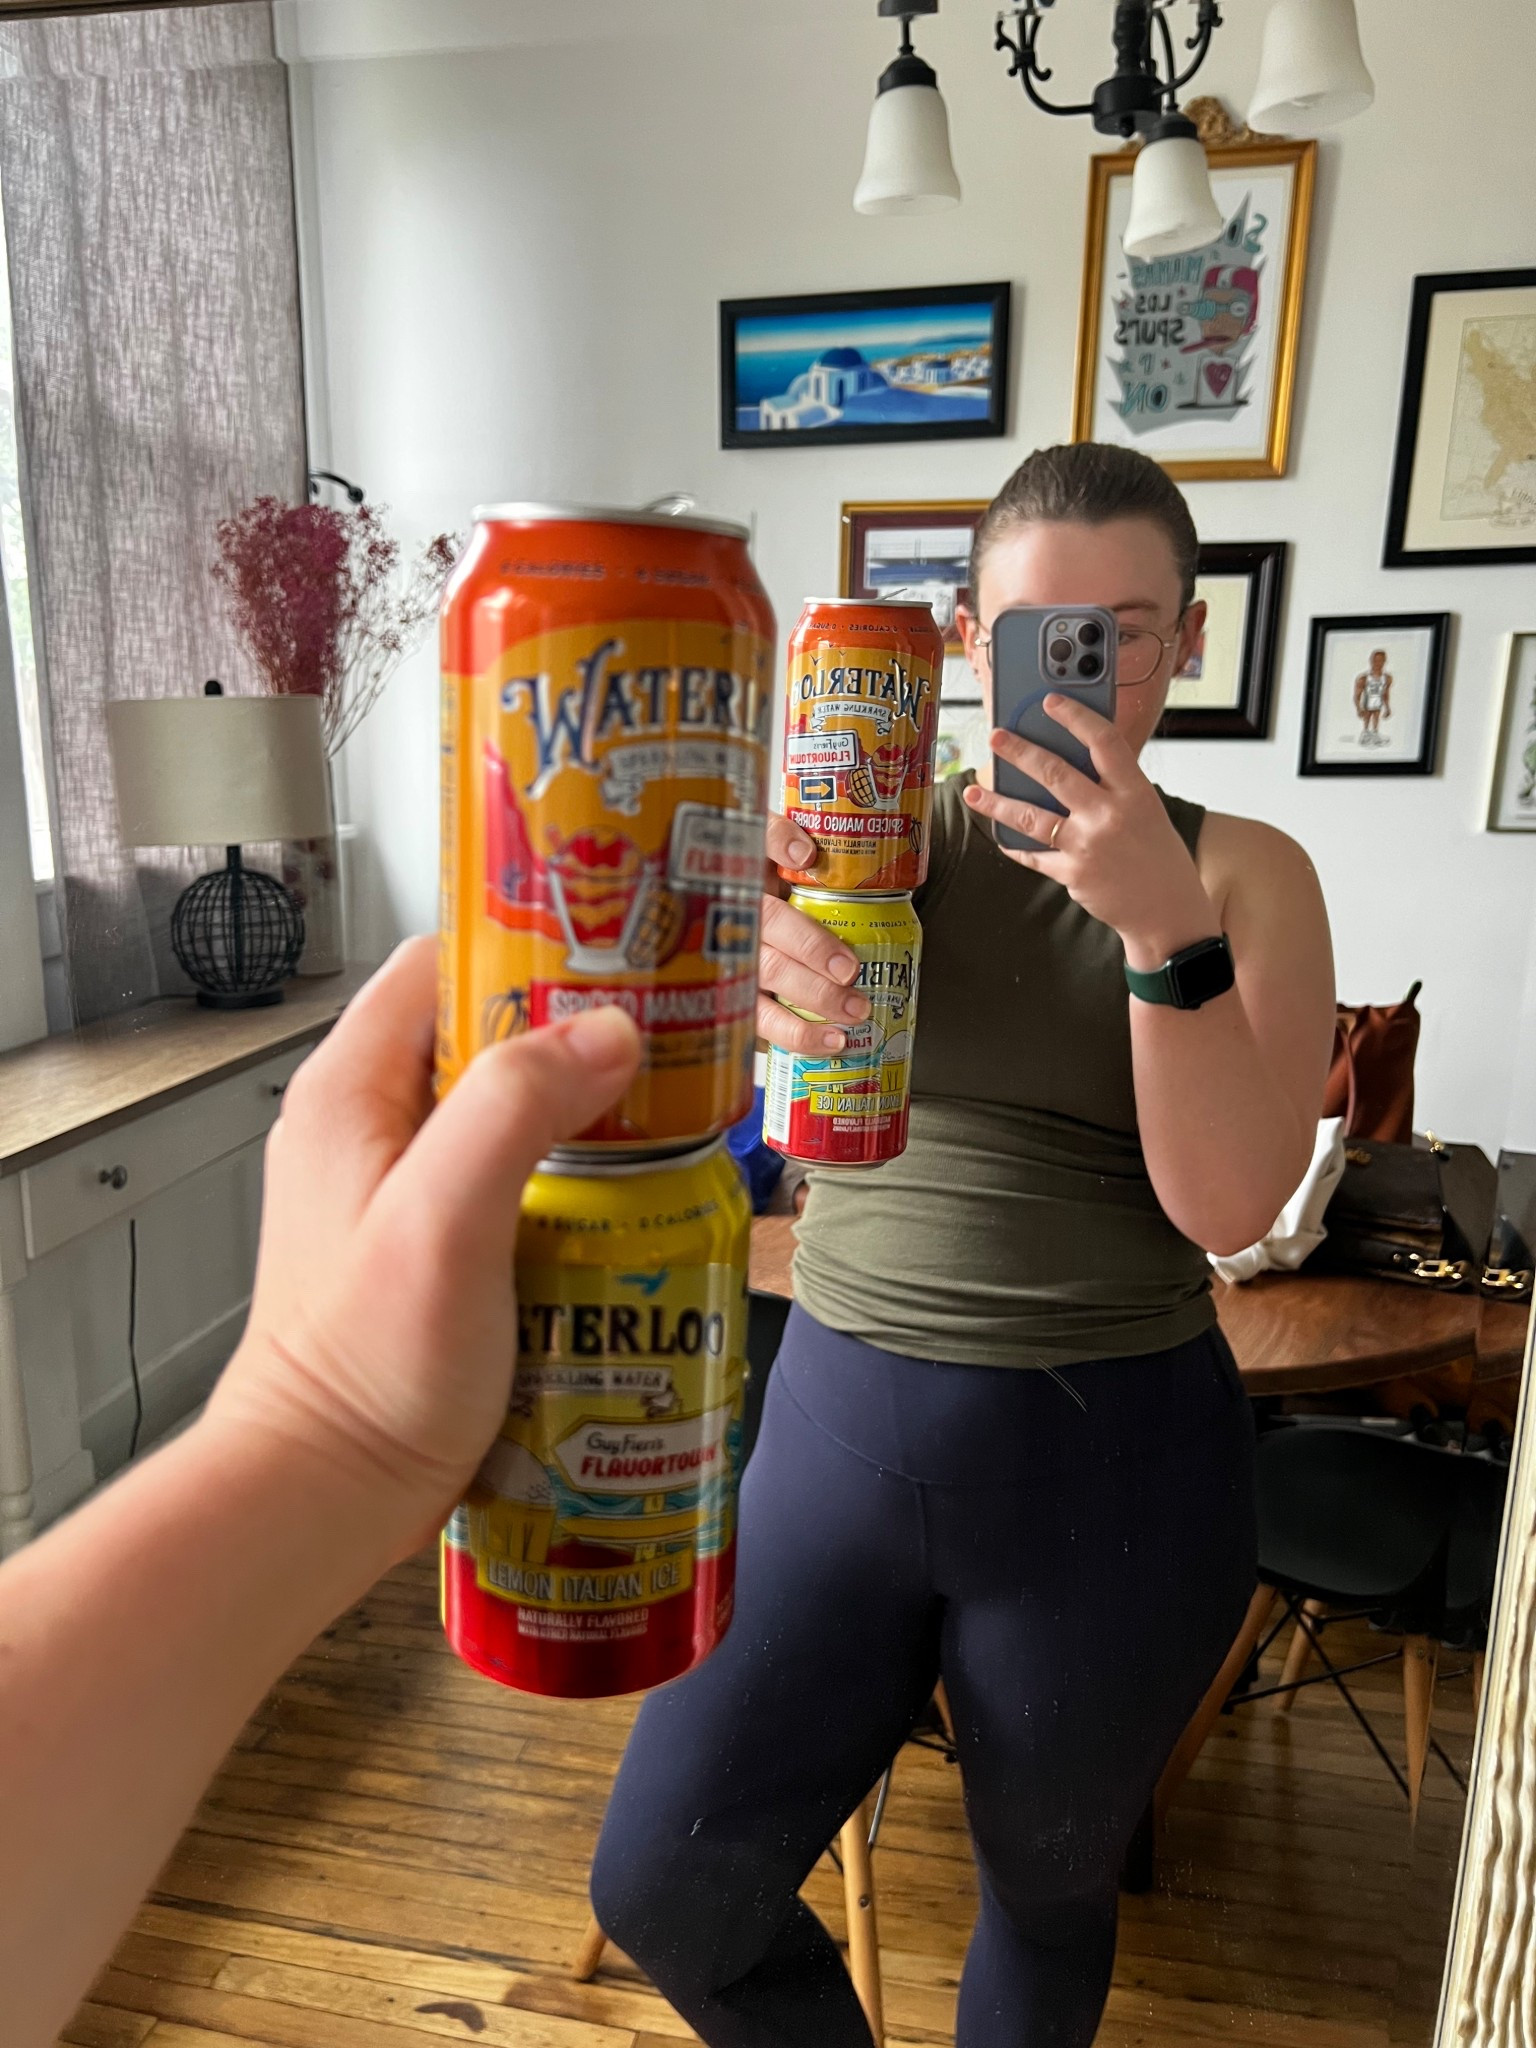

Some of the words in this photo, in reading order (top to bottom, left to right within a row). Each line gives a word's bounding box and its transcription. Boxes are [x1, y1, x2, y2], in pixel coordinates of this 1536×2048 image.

[518, 1303, 725, 1358] TERLOO
[613, 1369, 663, 1387] WATER
[587, 1431, 620, 1454] Guy
[488, 1560, 554, 1602] LEMON
[562, 1572, 643, 1603] ITALIAN
[652, 1560, 681, 1591] ICE
[518, 1606, 583, 1628] NATURALLY
[587, 1607, 649, 1627] FLAVORED
